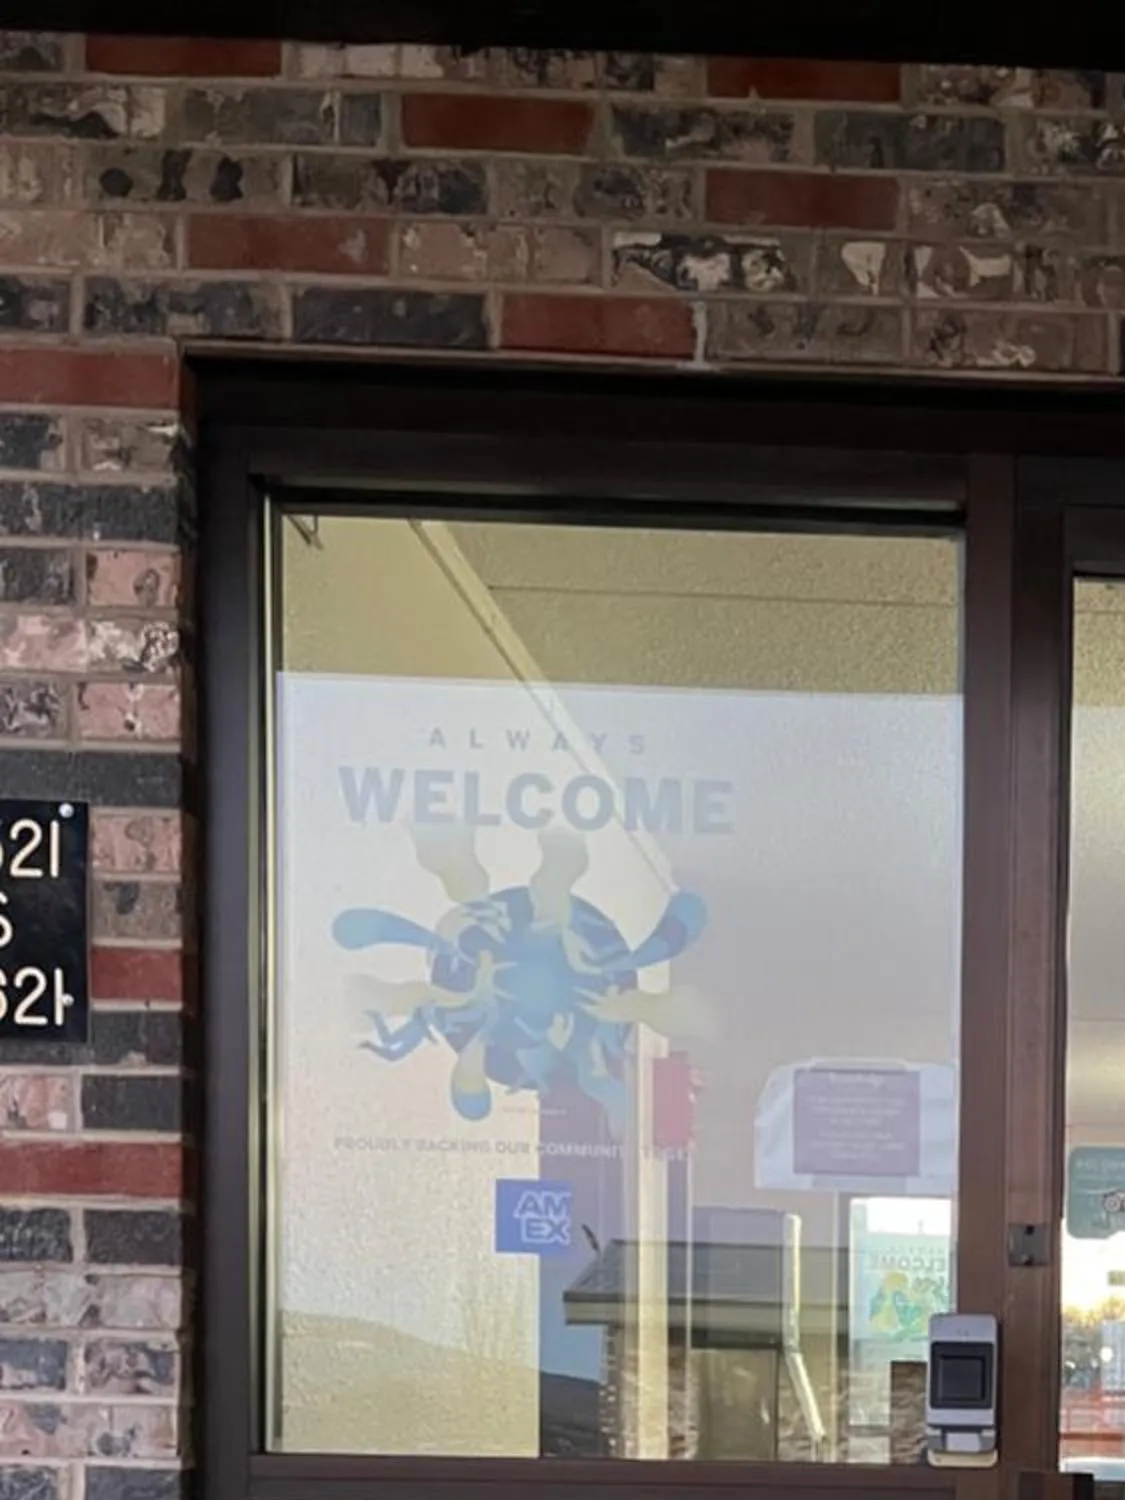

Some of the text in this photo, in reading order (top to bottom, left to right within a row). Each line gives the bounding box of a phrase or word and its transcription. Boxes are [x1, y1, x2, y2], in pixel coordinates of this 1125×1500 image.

[428, 727, 648, 755] ALWAYS
[340, 765, 735, 835] WELCOME
[0, 818, 60, 878] 21
[334, 1136, 410, 1151] PROUDLY
[417, 1137, 490, 1153] BACKING
[495, 1140, 532, 1155] OUR
[536, 1143, 627, 1159] COMMUNIT
